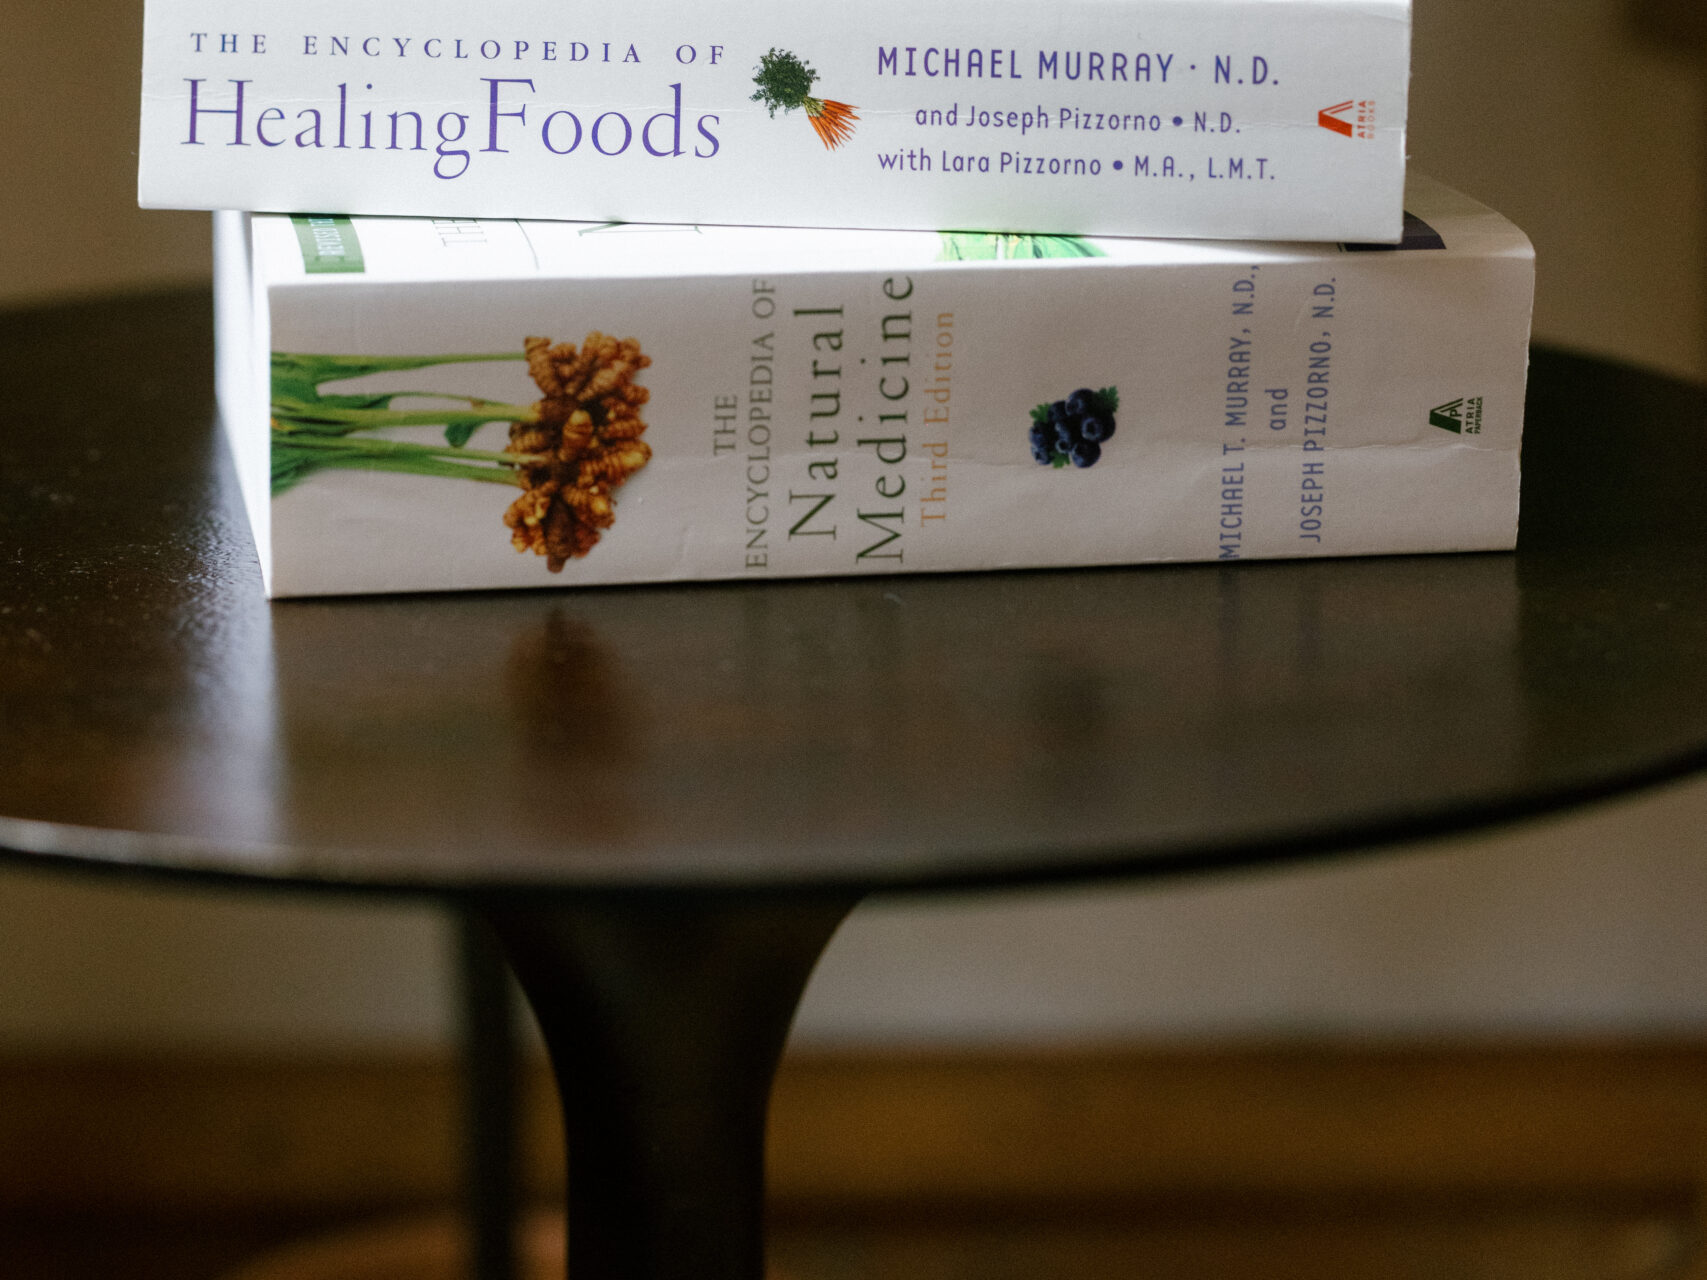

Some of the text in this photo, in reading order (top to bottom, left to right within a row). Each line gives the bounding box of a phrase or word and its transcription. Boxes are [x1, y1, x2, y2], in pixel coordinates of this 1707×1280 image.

[190, 32, 725, 65] THE ENCYCLOPEDIA OF
[878, 46, 1280, 86] MICHAEL MURRAY N.D.
[915, 102, 1241, 136] and Joseph Pizzorno N.D.
[1356, 100, 1367, 139] ATRIA
[877, 147, 1276, 181] with Lara Pizzorno M.A., L.M.T.
[1224, 328, 1252, 427] MURRAY,
[713, 394, 738, 456] THE
[745, 278, 776, 569] ENCYCLOPEDIA OF
[788, 304, 844, 541] Natural
[855, 276, 914, 564] Medicine
[920, 312, 954, 528] Third Edition
[1264, 388, 1289, 431] and
[1299, 277, 1337, 543] JOSEPH PIZZORNO, N.D.
[1465, 397, 1475, 434] ATRIA
[1222, 437, 1246, 456] T.
[1218, 463, 1244, 559] MICHAEL
